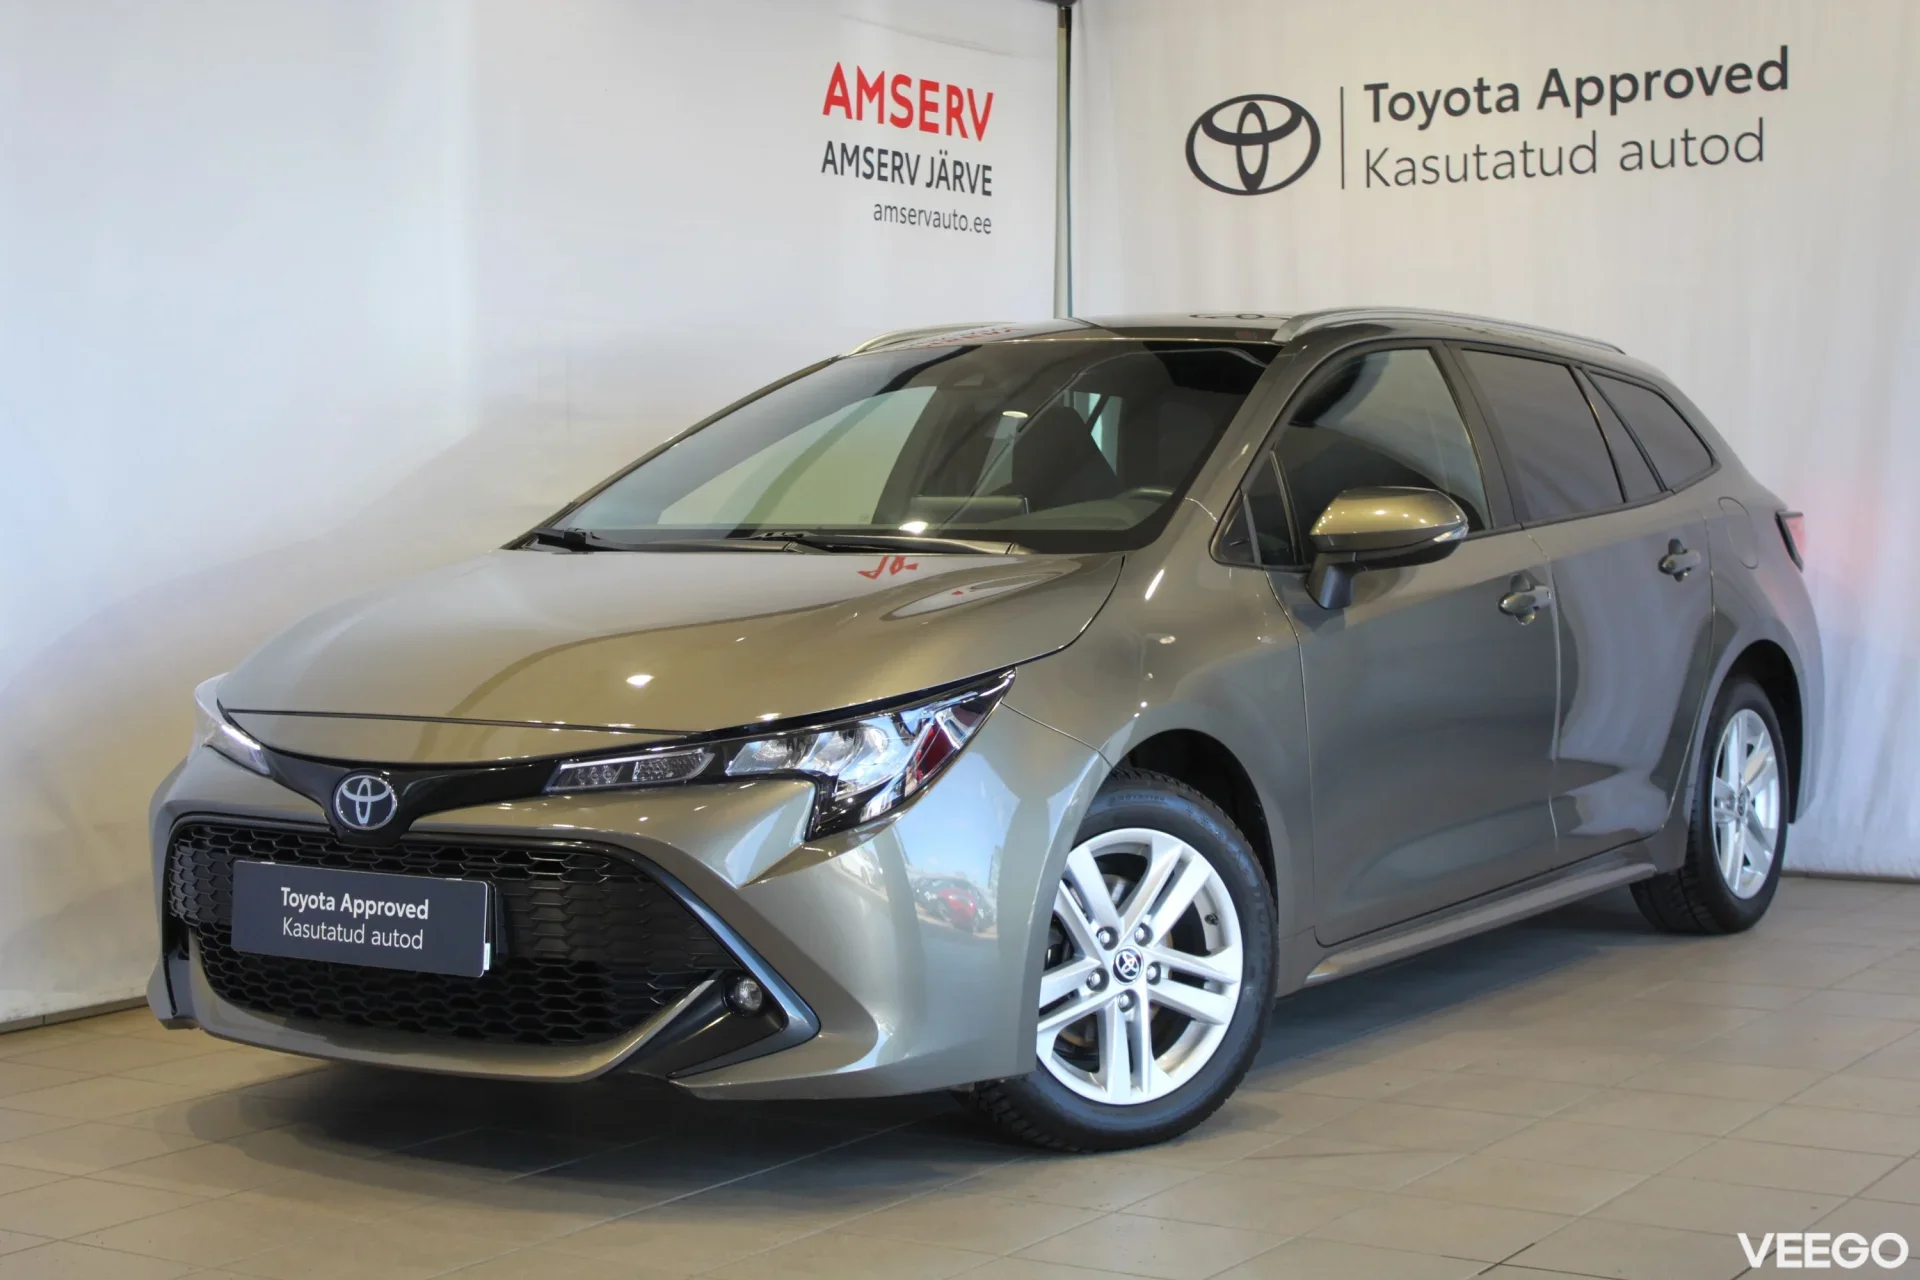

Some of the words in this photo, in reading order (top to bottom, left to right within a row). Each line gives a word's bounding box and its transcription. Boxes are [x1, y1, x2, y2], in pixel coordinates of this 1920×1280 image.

[822, 61, 994, 142] AMSERV
[1363, 77, 1521, 131] Toyota
[1536, 44, 1790, 119] Approved
[821, 140, 921, 186] AMSERV
[925, 148, 992, 197] JÄRVE
[1364, 129, 1598, 189] Kasutatud
[1618, 116, 1764, 172] autod
[873, 202, 992, 235] amservauto.ee
[281, 886, 336, 913] Toyota
[340, 892, 429, 920] Approved
[283, 916, 365, 944] Kasutatud
[371, 928, 424, 950] autod
